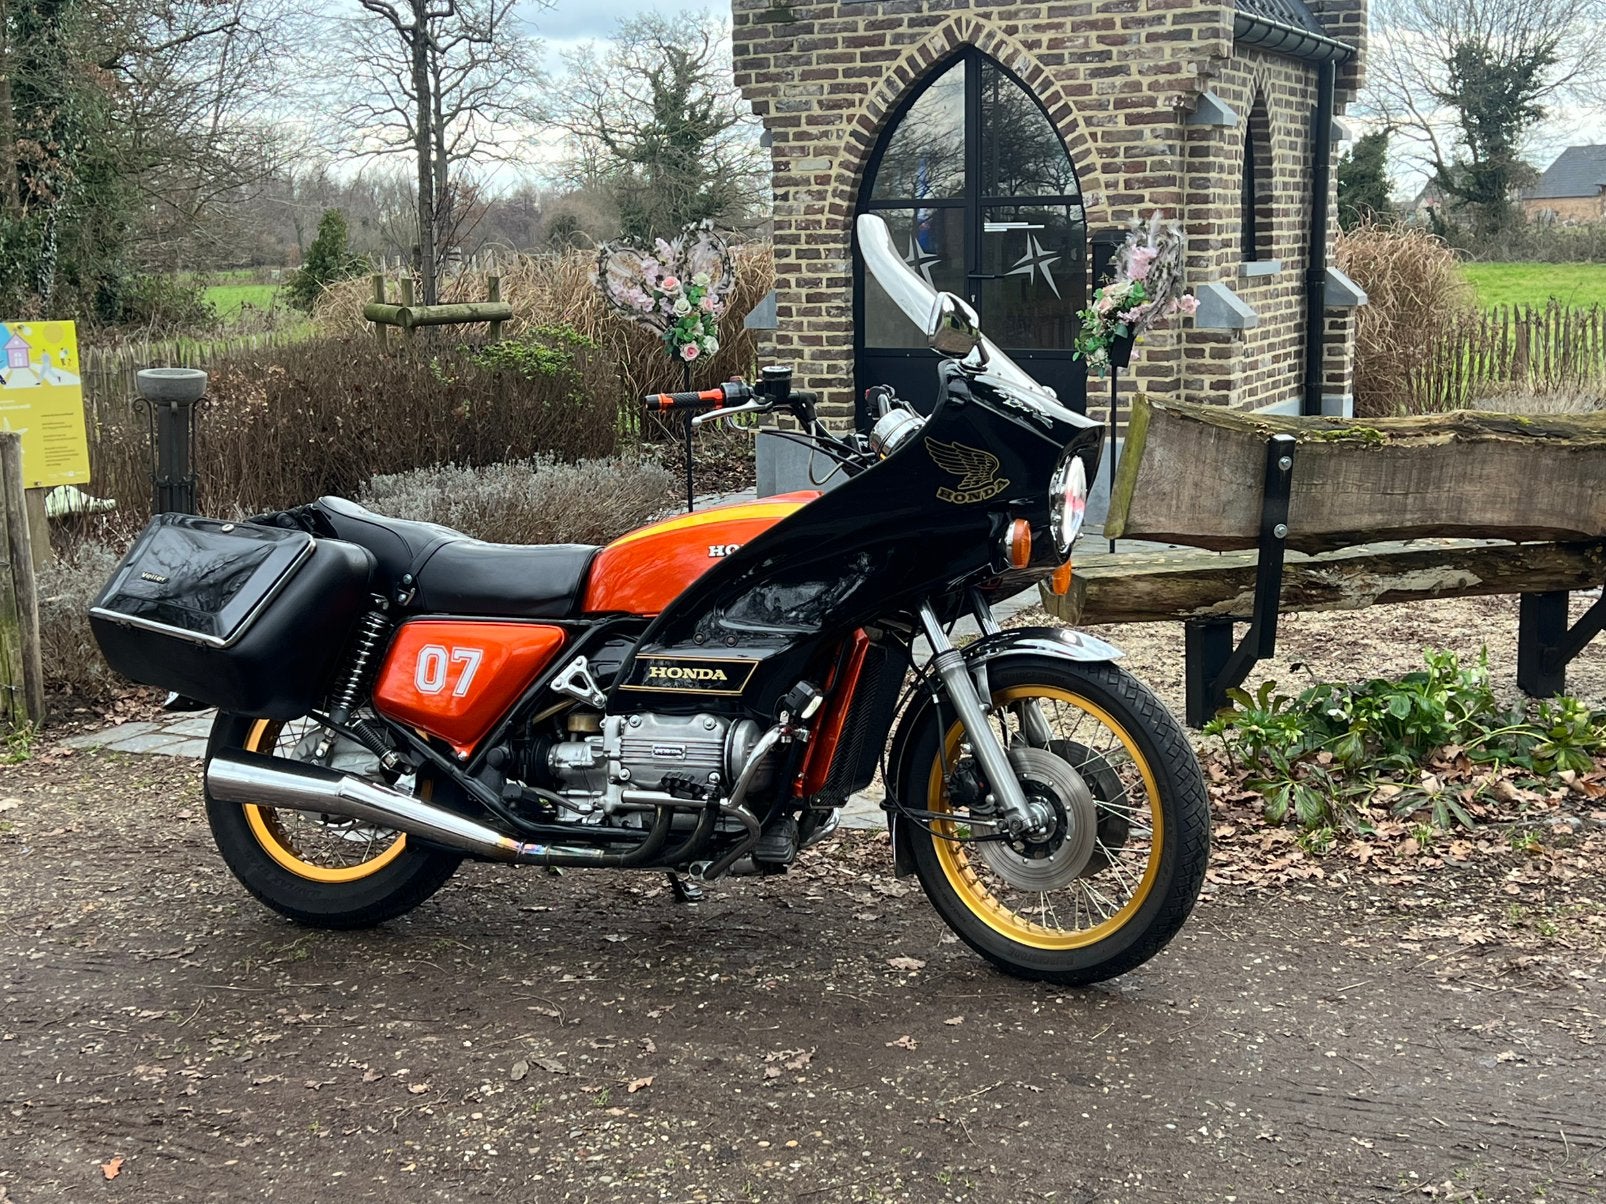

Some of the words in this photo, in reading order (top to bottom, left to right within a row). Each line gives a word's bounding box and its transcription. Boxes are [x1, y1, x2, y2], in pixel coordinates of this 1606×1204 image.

[936, 478, 1010, 504] HONDA
[708, 543, 745, 557] HO
[414, 643, 484, 697] 07
[650, 667, 728, 681] HONDA
